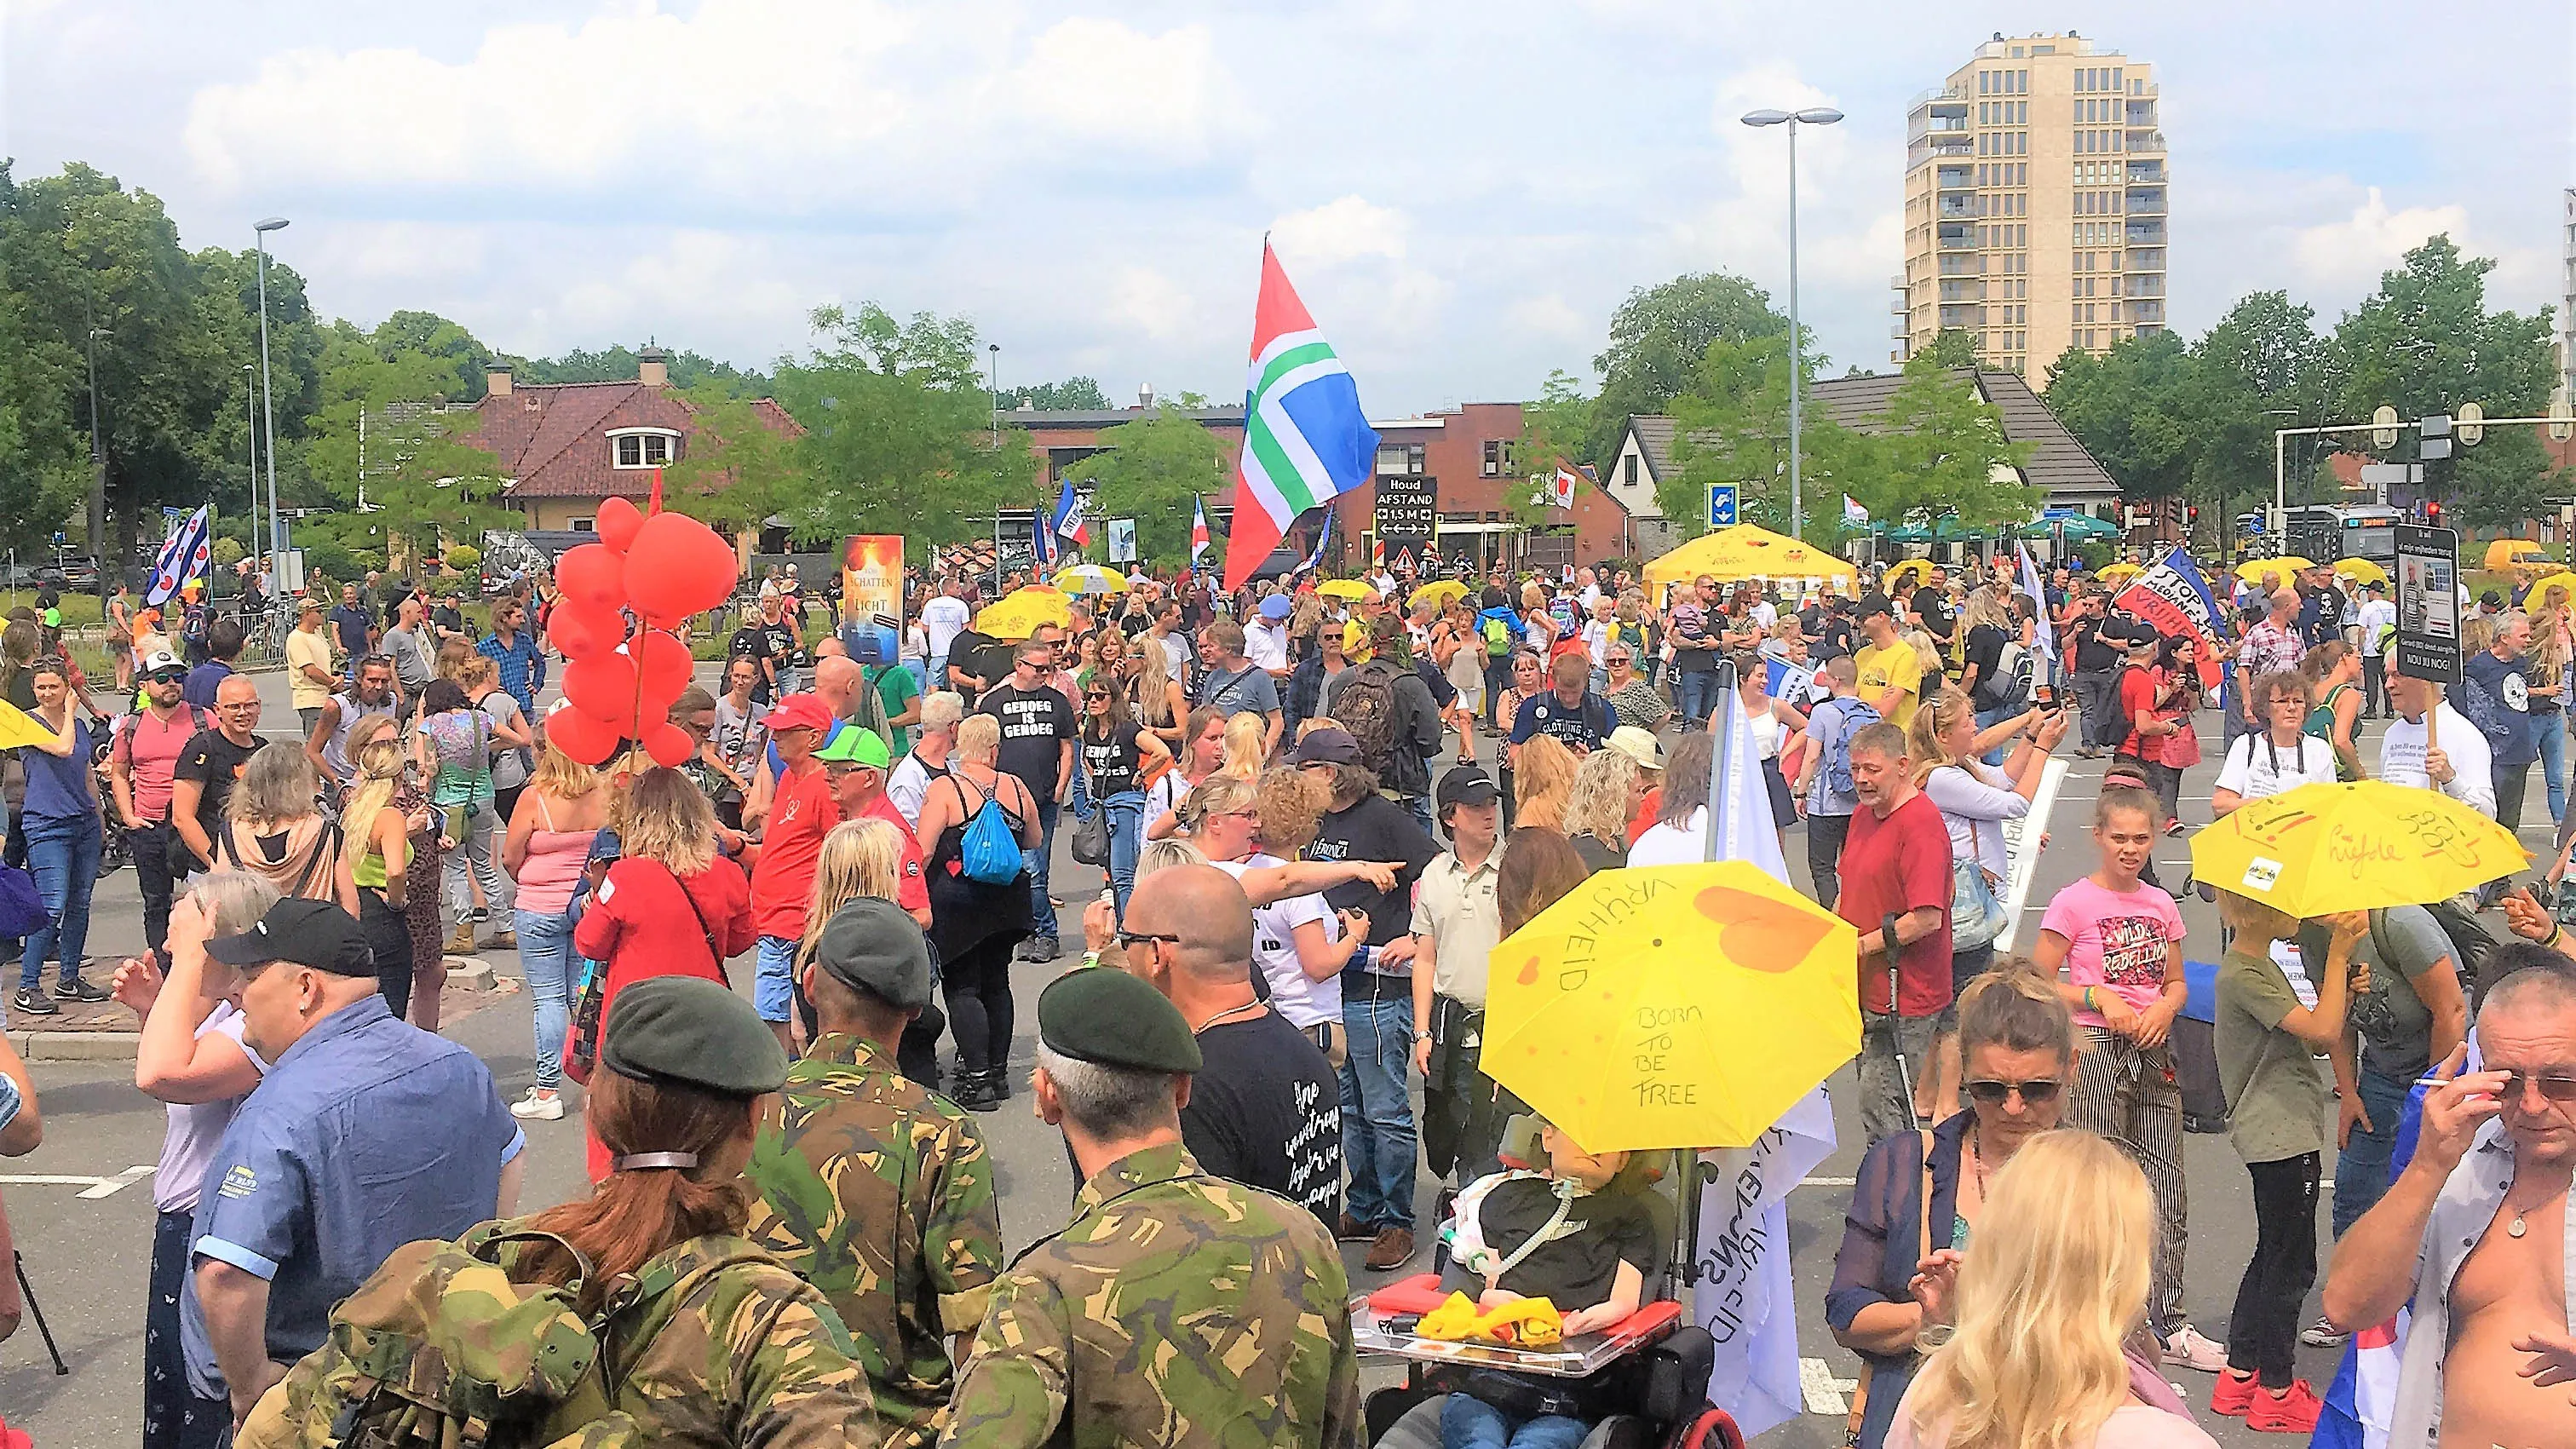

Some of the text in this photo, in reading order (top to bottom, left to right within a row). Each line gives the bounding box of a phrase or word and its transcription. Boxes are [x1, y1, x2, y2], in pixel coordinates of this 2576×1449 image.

[1390, 479, 1421, 490] Houd
[1377, 494, 1433, 505] AFSTAND
[1389, 509, 1417, 521] 1,5 M
[850, 577, 893, 588] SCHATTEN
[2154, 570, 2201, 606] STOP
[855, 599, 888, 612] LICHT
[2406, 653, 2422, 665] NOU
[1002, 700, 1053, 716] GENOEG
[1021, 712, 1037, 725] IS
[1003, 722, 1055, 739] GENOEG
[2113, 923, 2146, 946] WILD
[2101, 941, 2169, 973] REBELLION
[1636, 1032, 1672, 1052] TO
[1632, 1055, 1666, 1072] BE
[1631, 1077, 1698, 1107] FREE
